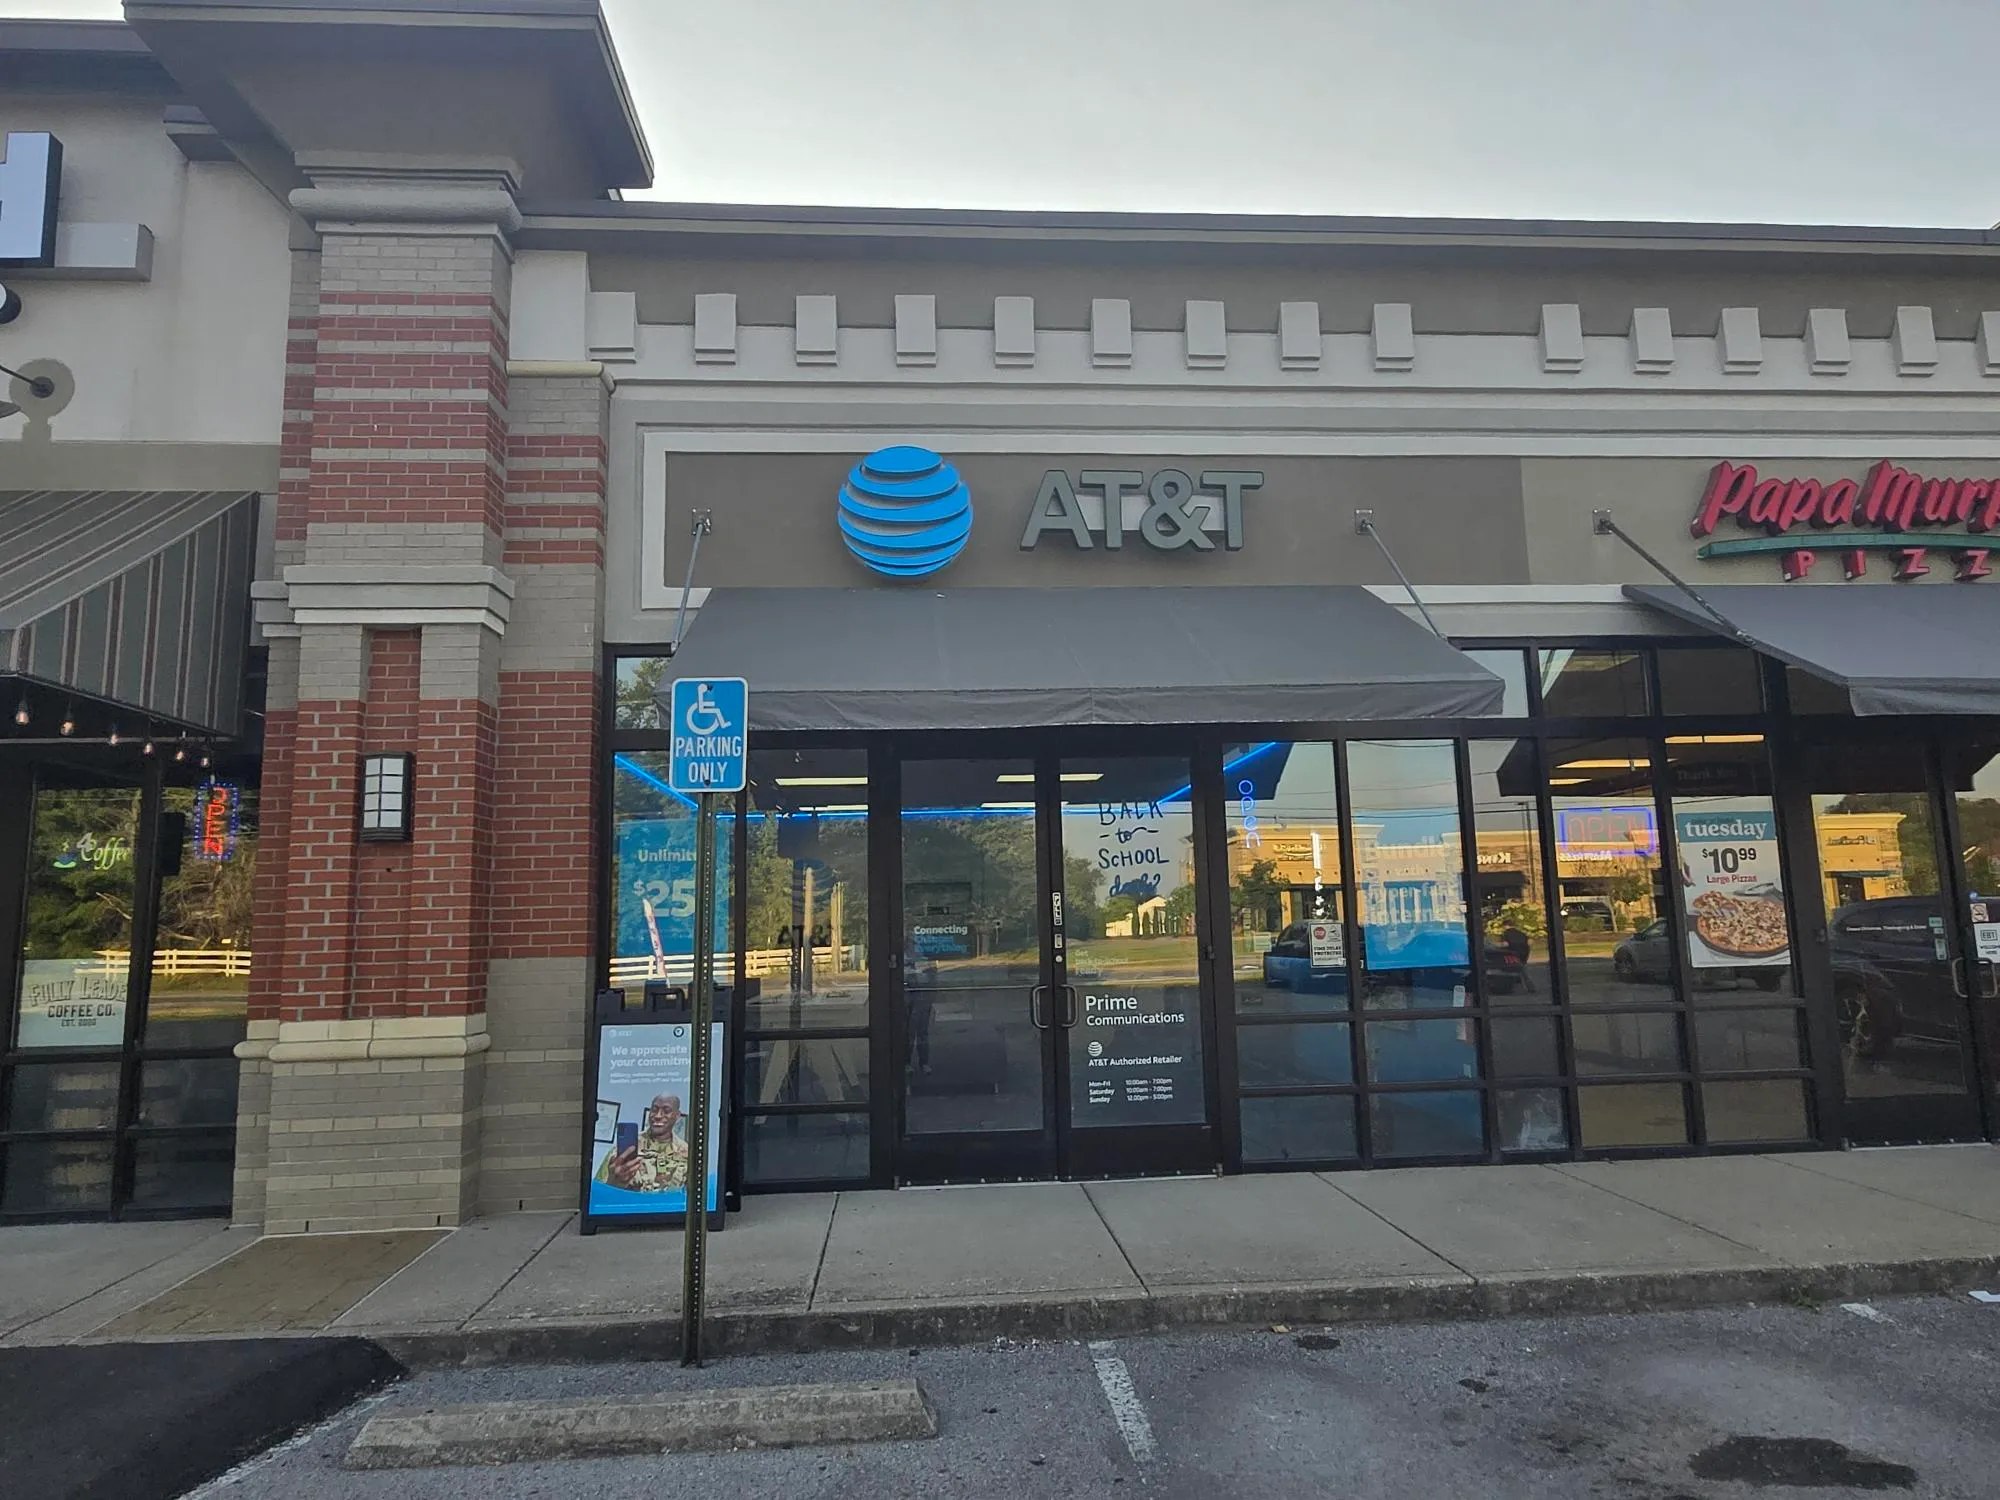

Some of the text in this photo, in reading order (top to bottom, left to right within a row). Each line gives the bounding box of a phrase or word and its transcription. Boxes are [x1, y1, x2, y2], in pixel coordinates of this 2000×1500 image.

[1691, 461, 1859, 538] Papa
[1021, 469, 1264, 551] AT&T
[676, 736, 742, 757] PARKING
[688, 762, 728, 783] ONLY
[205, 787, 229, 855] OPEN
[1685, 819, 1768, 839] tuesday
[1706, 874, 1757, 884] Large Pizzas
[913, 925, 968, 935] Connecting
[1085, 994, 1138, 1011] Prime
[48, 1003, 116, 1018] COFFEE CO.
[1086, 1012, 1185, 1026] Communications
[611, 1044, 688, 1058] We appreciate
[610, 1056, 690, 1070] your commitm
[1088, 1055, 1183, 1067] AT&T Authorized Retailer
[1089, 1088, 1115, 1096] Saturday
[1089, 1096, 1111, 1104] Sunday
